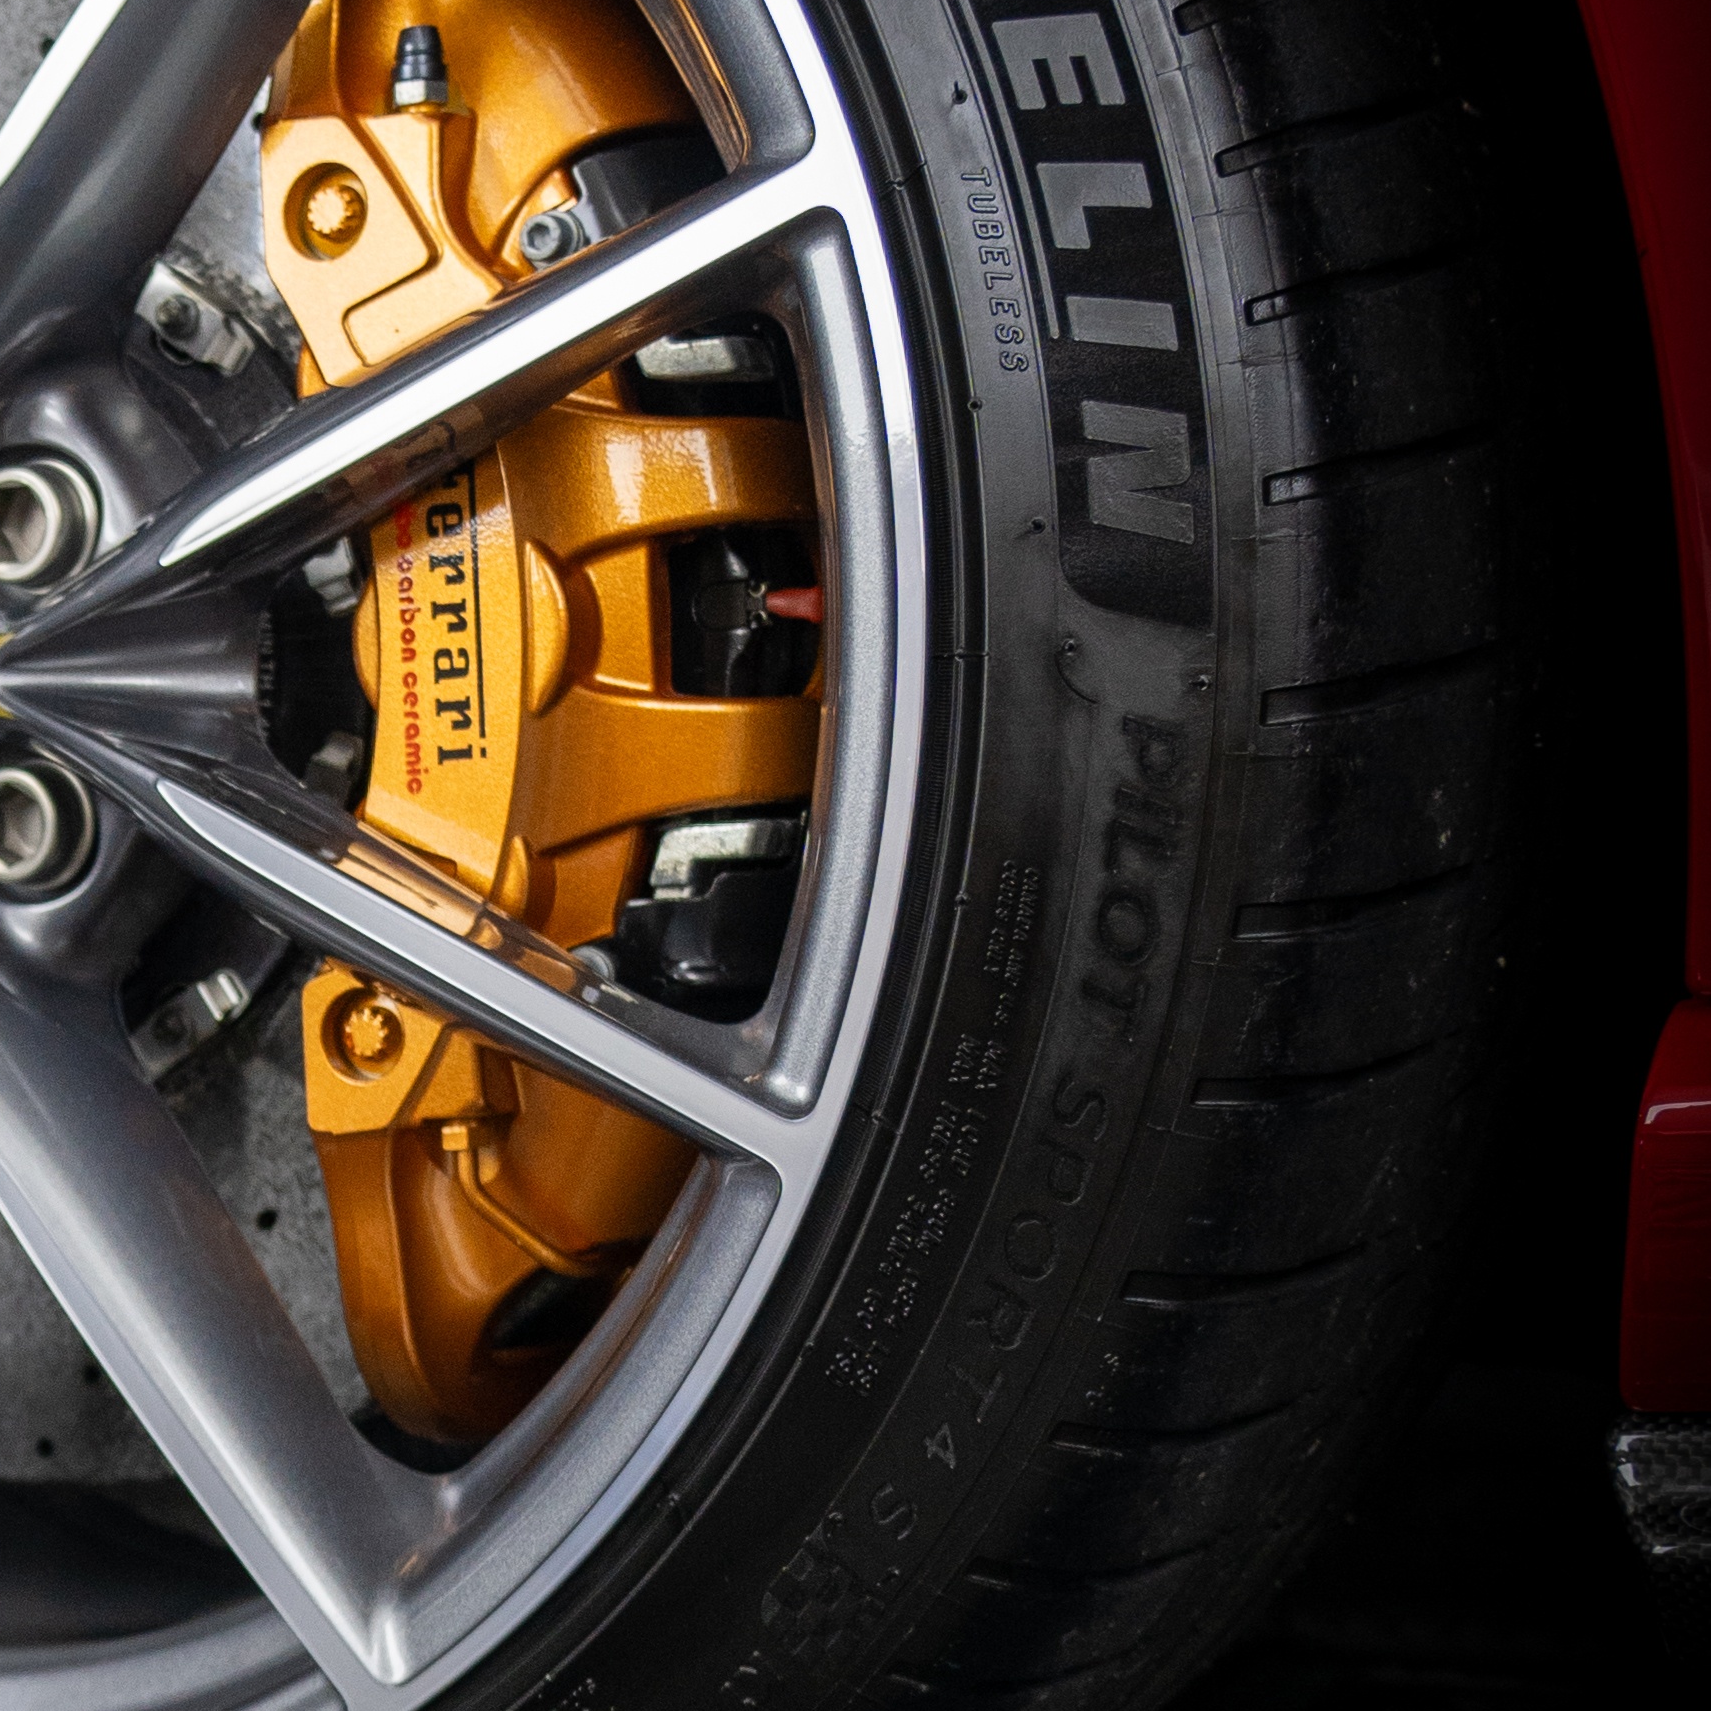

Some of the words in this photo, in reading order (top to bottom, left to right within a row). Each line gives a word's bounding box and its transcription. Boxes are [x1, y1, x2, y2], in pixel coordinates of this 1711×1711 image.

[959, 166, 1030, 374] TUBELESS
[395, 555, 418, 661] carbon
[400, 670, 431, 796] ceramic
[1082, 714, 1187, 1043] PILOT
[945, 1075, 1108, 1424] SPORT
